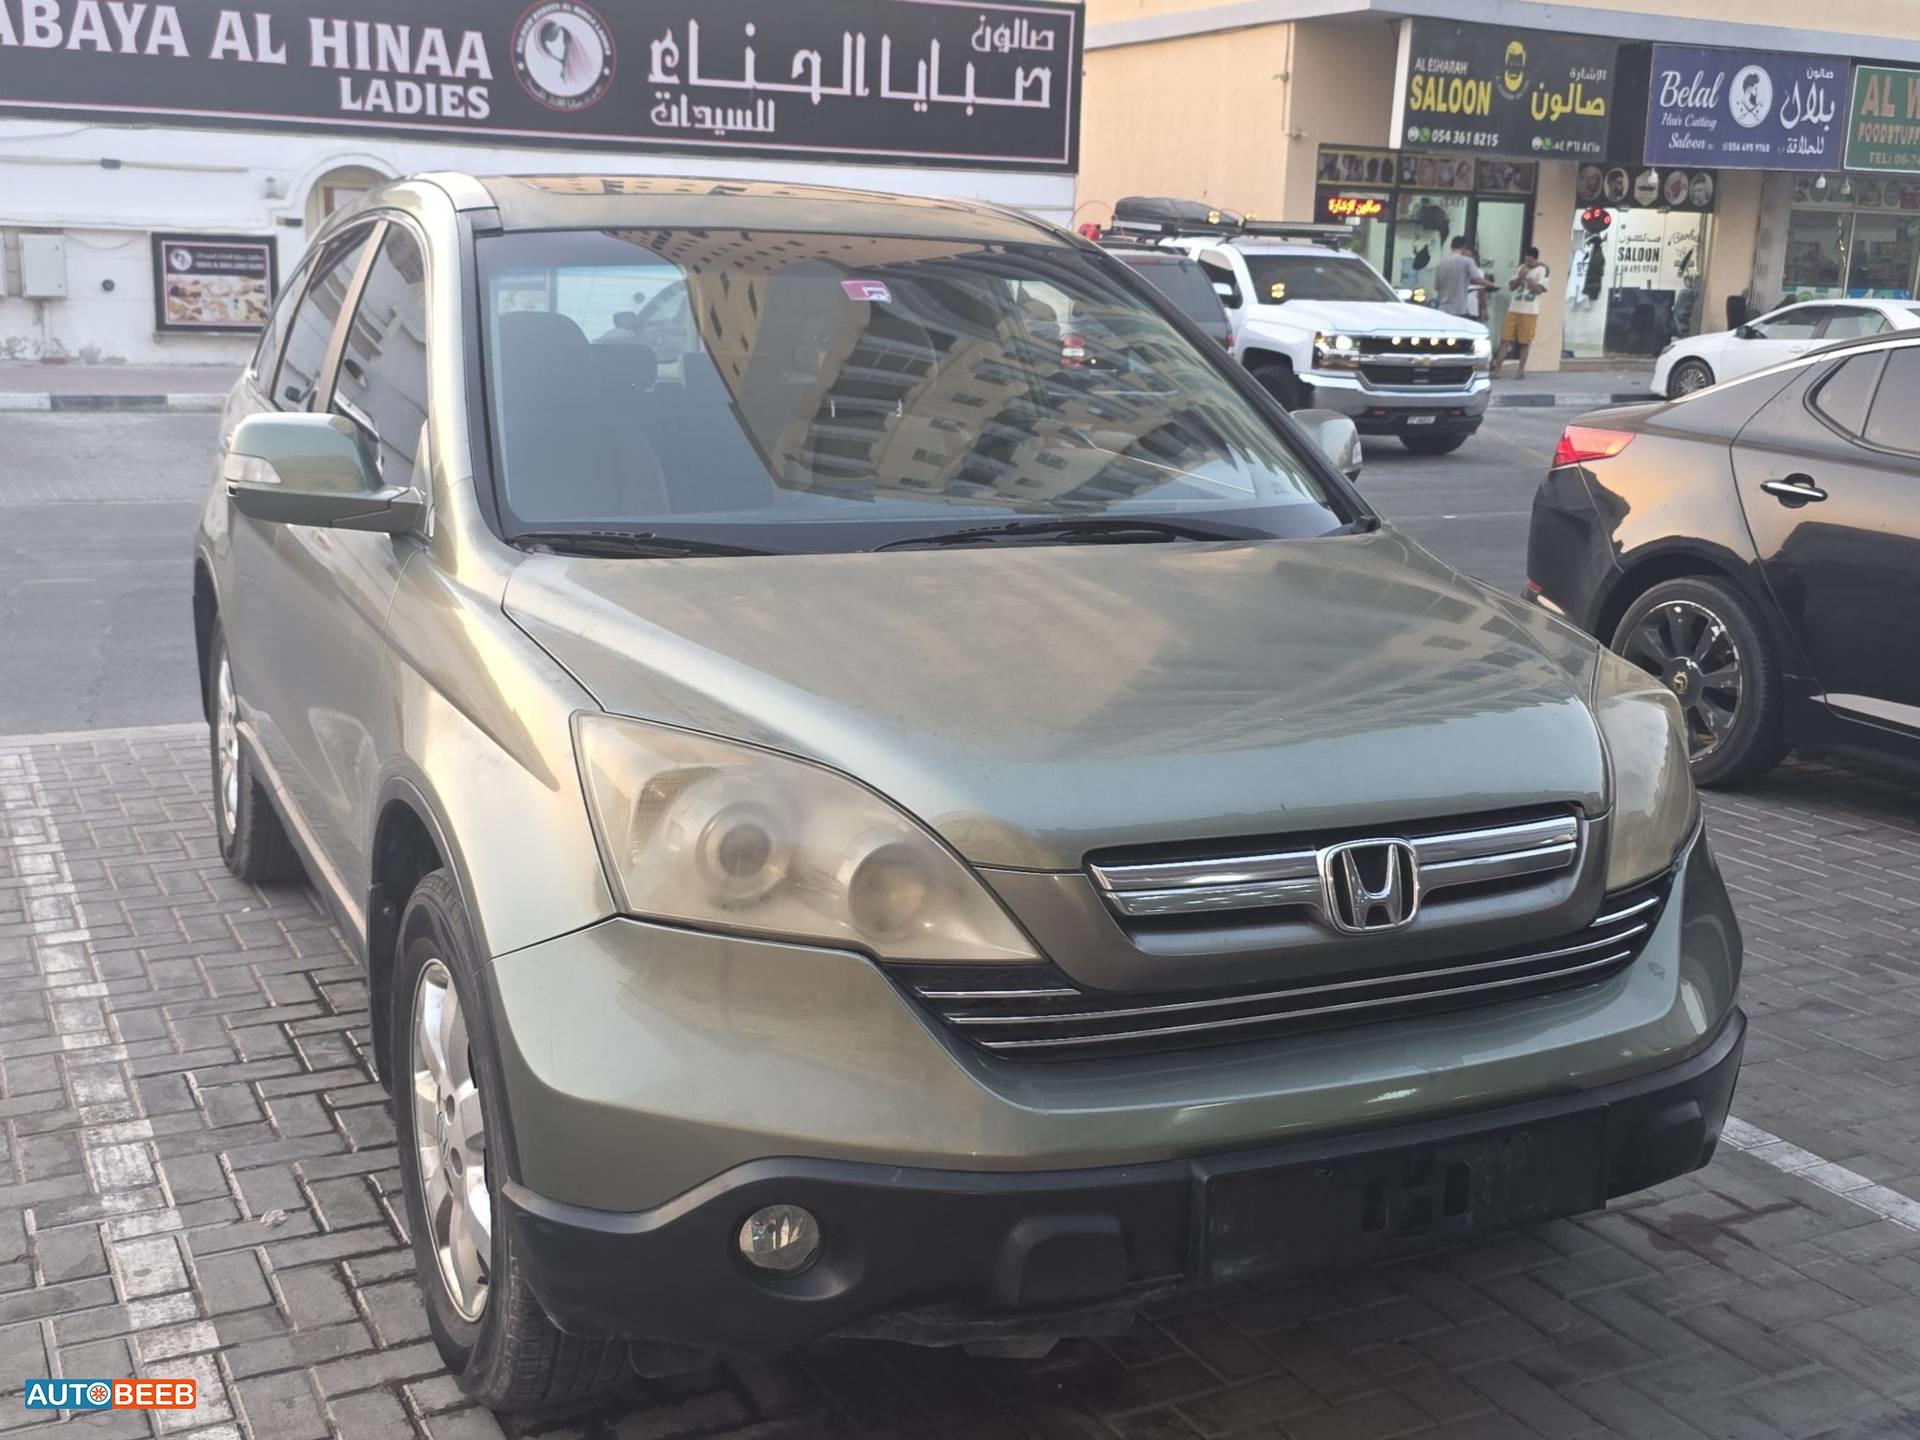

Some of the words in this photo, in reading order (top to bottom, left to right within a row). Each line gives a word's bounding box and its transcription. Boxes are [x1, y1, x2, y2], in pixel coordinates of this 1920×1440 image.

[209, 10, 287, 65] AL
[308, 17, 494, 80] HINAA
[971, 14, 1055, 53] صالون
[880, 34, 1052, 116] صبايا
[1415, 57, 1425, 72] AL
[1806, 67, 1834, 80] صالون
[339, 77, 490, 119] LADIES
[1410, 74, 1492, 116] SALOON
[1531, 82, 1605, 121] صالون
[1660, 70, 1725, 108] Belal
[1780, 80, 1835, 131] بلال
[1861, 75, 1896, 117] AL
[650, 91, 775, 136] للسيدات
[1661, 113, 1682, 126] Hair
[1684, 114, 1717, 131] Cutting
[1431, 128, 1451, 143] 054
[1452, 130, 1471, 145] 361
[1473, 132, 1499, 147] 8215
[1668, 132, 1706, 150] Saloon
[1618, 247, 1660, 262] SALOON
